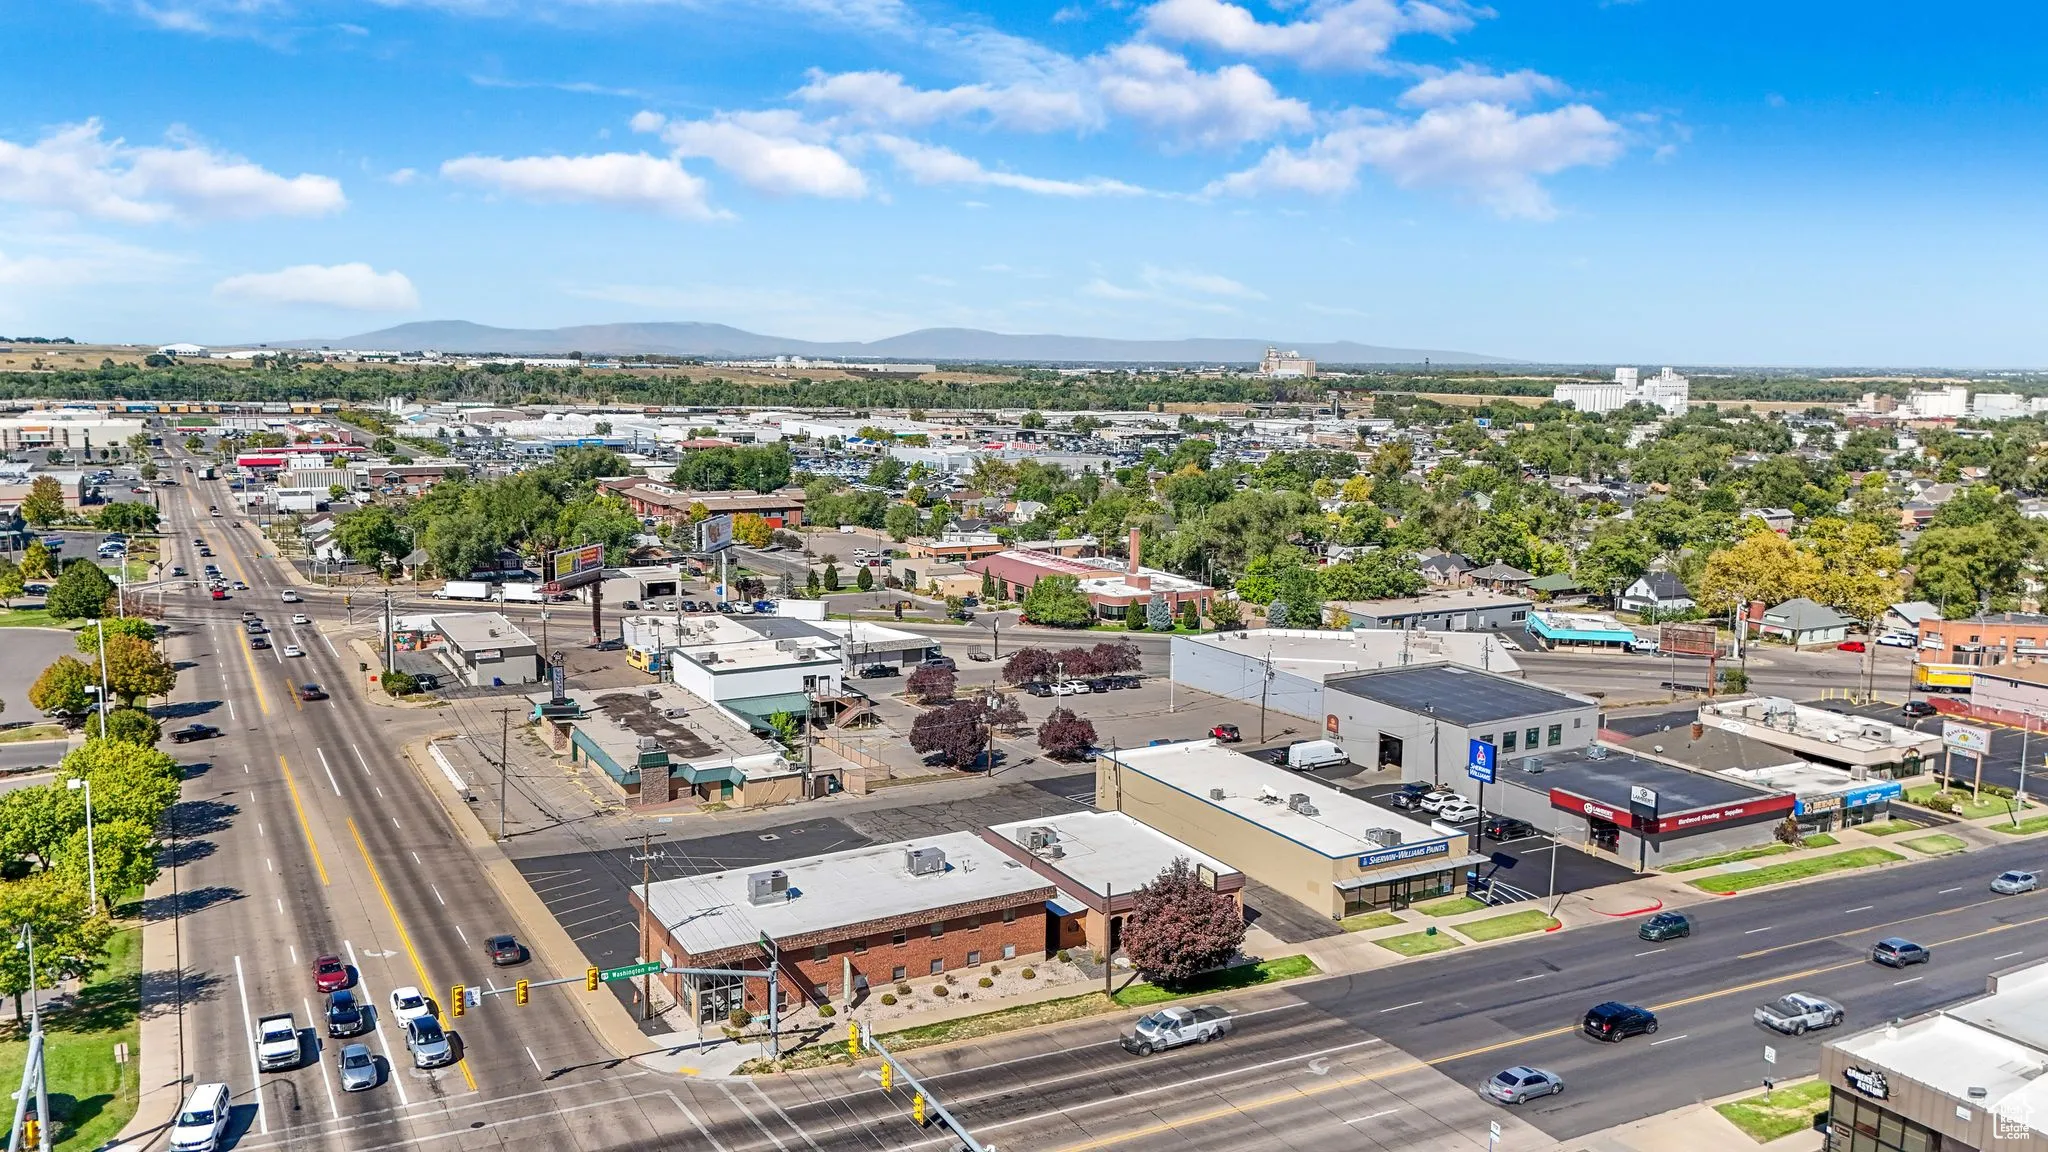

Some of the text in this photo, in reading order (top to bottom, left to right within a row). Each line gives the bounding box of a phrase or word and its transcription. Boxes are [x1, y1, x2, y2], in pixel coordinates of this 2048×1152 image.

[1678, 808, 1744, 825] Hardwood Flooring Supplies
[612, 967, 645, 978] Washington
[1847, 1068, 1873, 1085] GAMERS
[1857, 1080, 1884, 1098] ASYLUM
